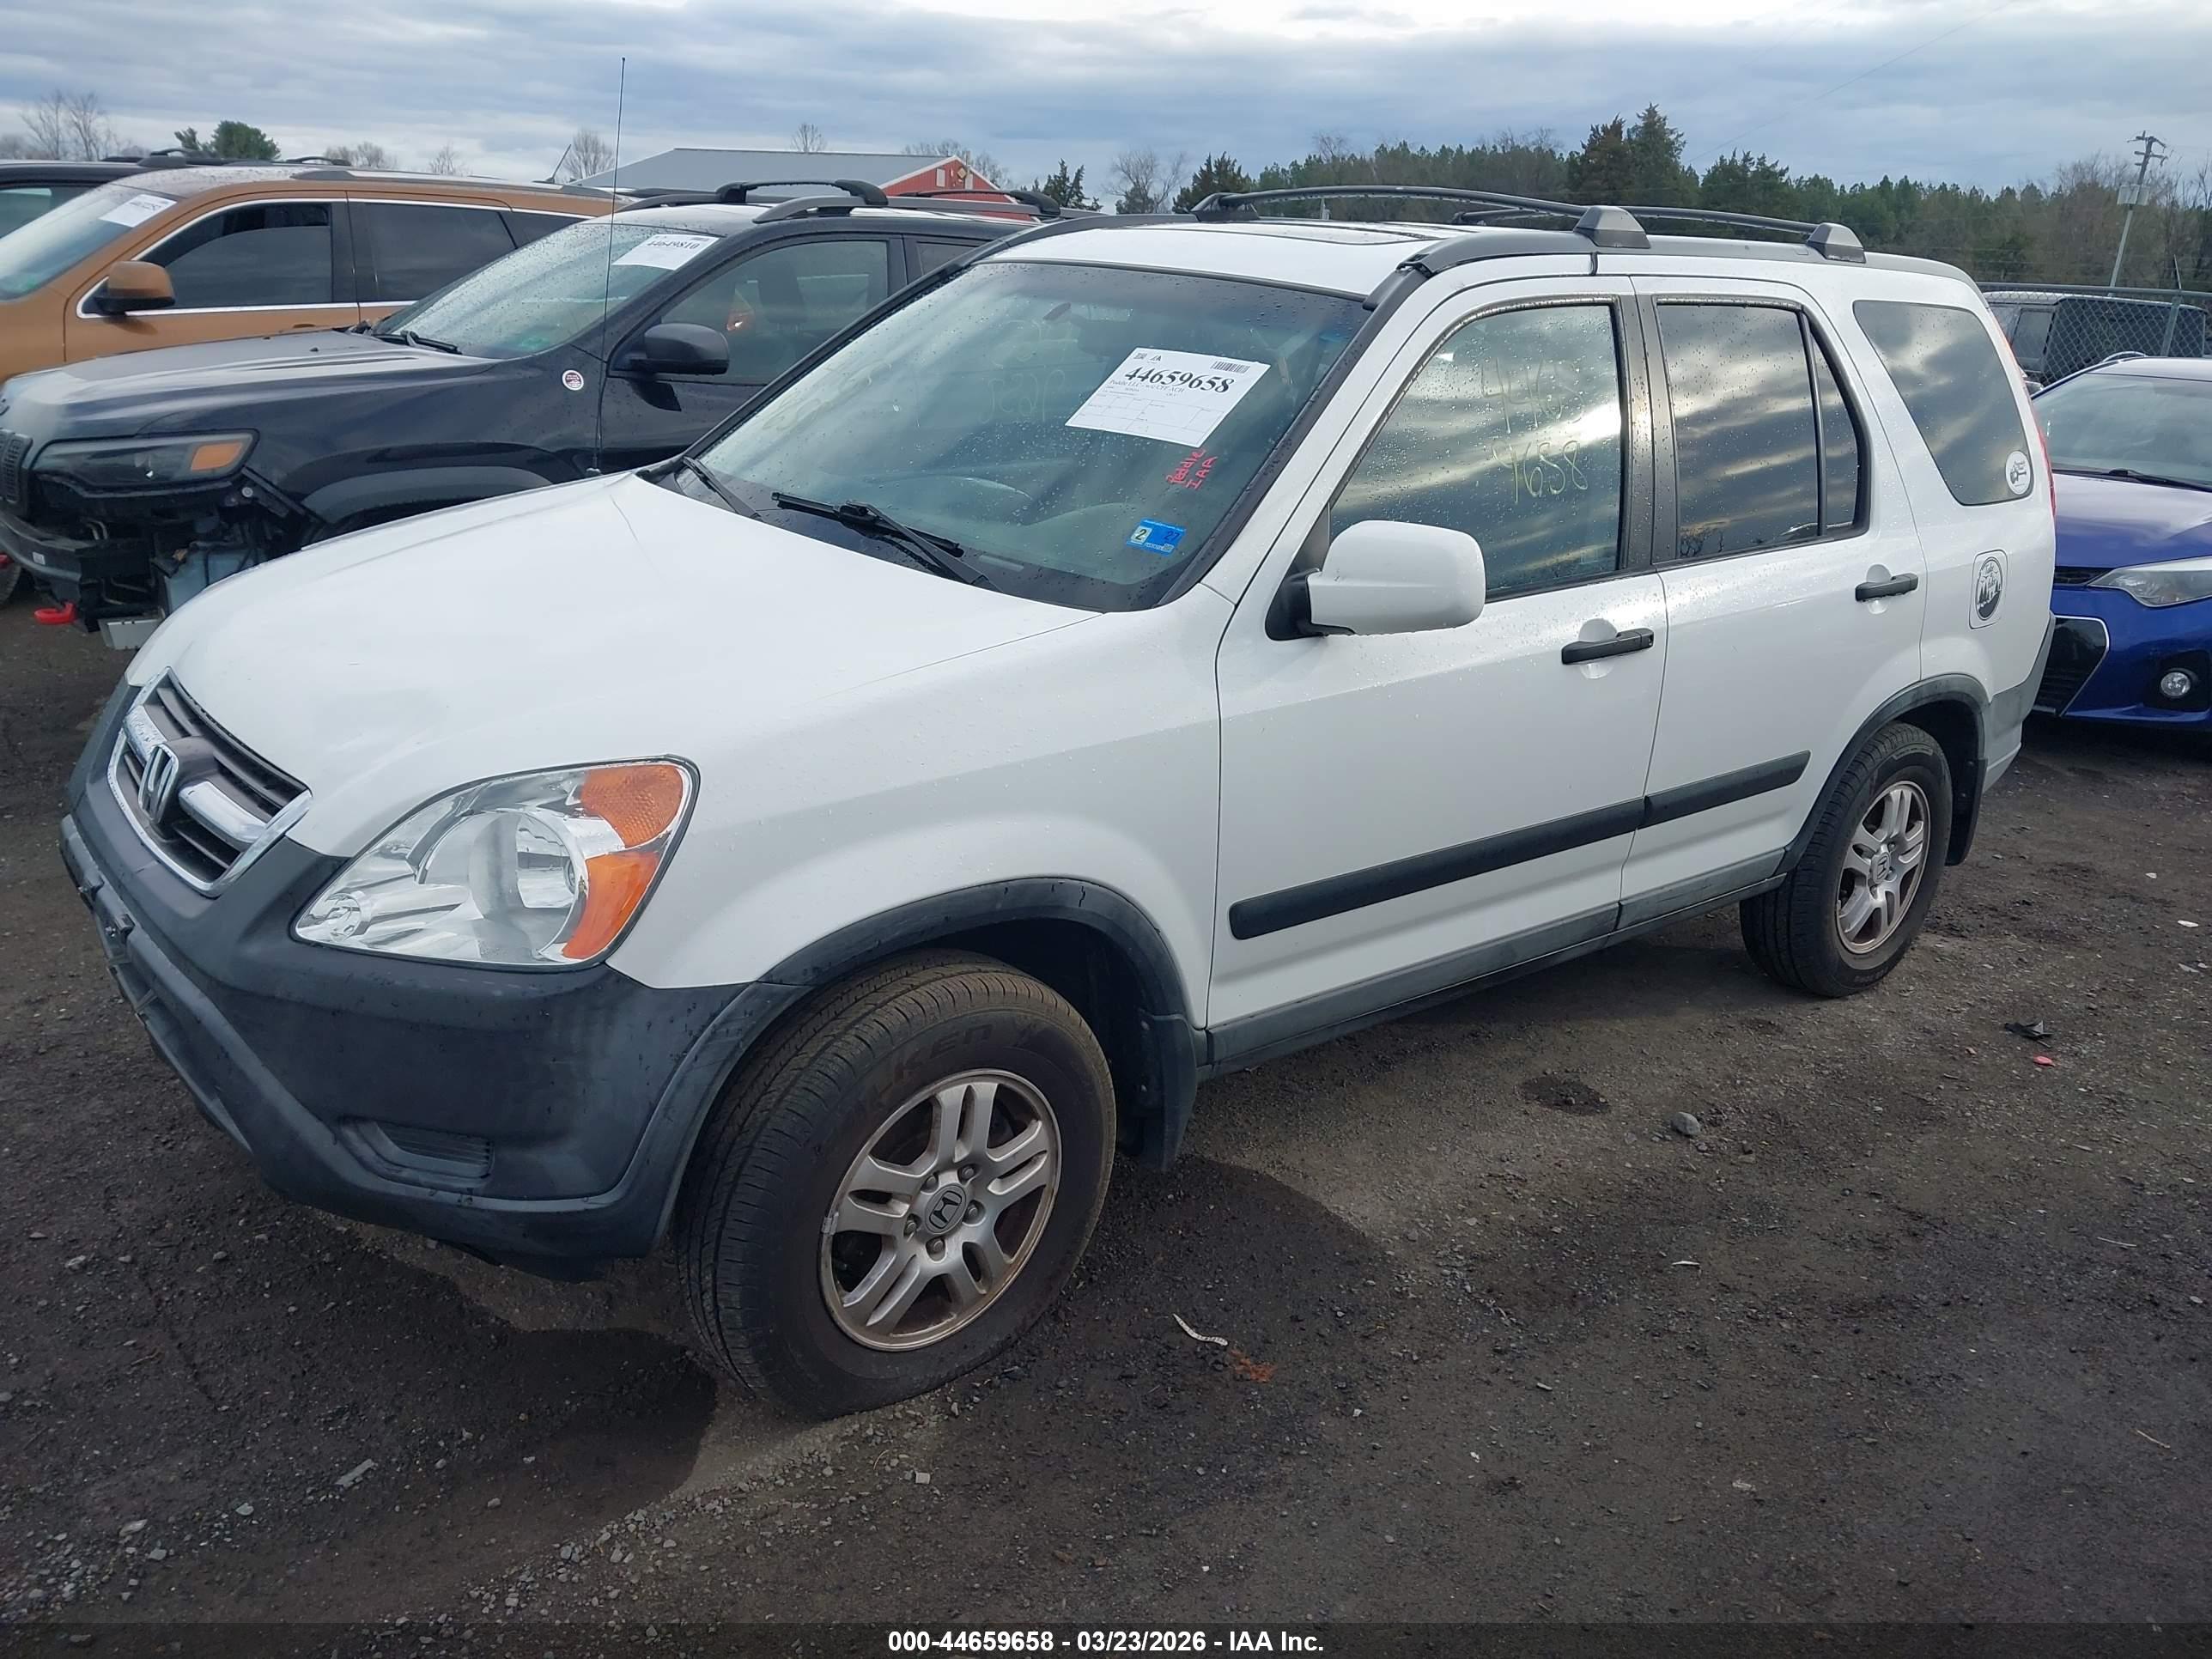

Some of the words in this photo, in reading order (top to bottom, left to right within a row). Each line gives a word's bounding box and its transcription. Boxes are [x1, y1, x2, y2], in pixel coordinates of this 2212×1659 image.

[1125, 366, 1235, 393] 44659658
[1492, 439, 1588, 505] 9658
[1135, 528, 1147, 541] 2
